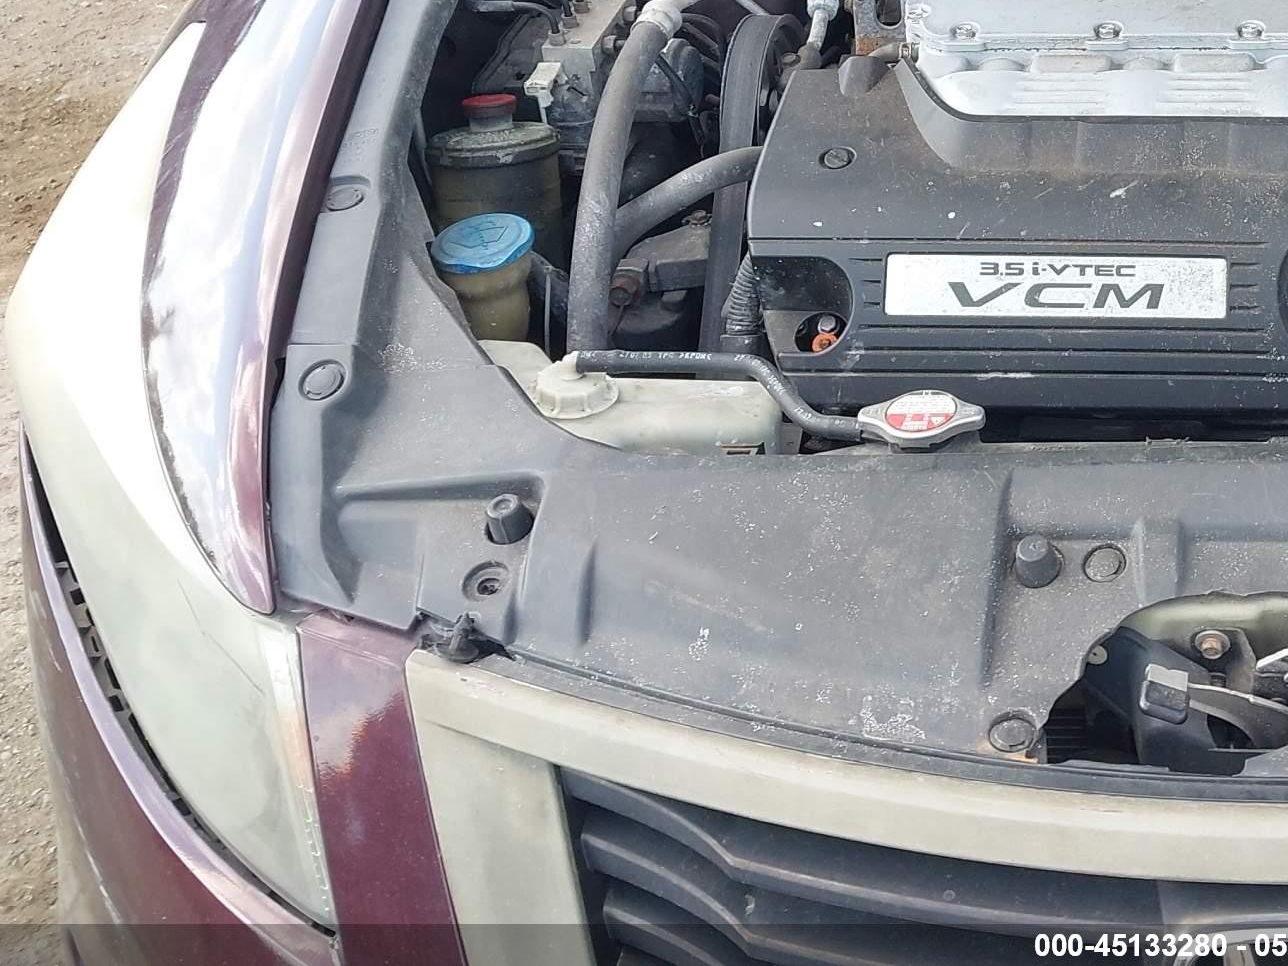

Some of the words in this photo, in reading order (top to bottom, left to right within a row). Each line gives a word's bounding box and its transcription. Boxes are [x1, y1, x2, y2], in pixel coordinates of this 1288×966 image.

[979, 261, 1025, 277] 3.5
[1031, 261, 1136, 277] i-VTEC
[947, 281, 1165, 309] VCM
